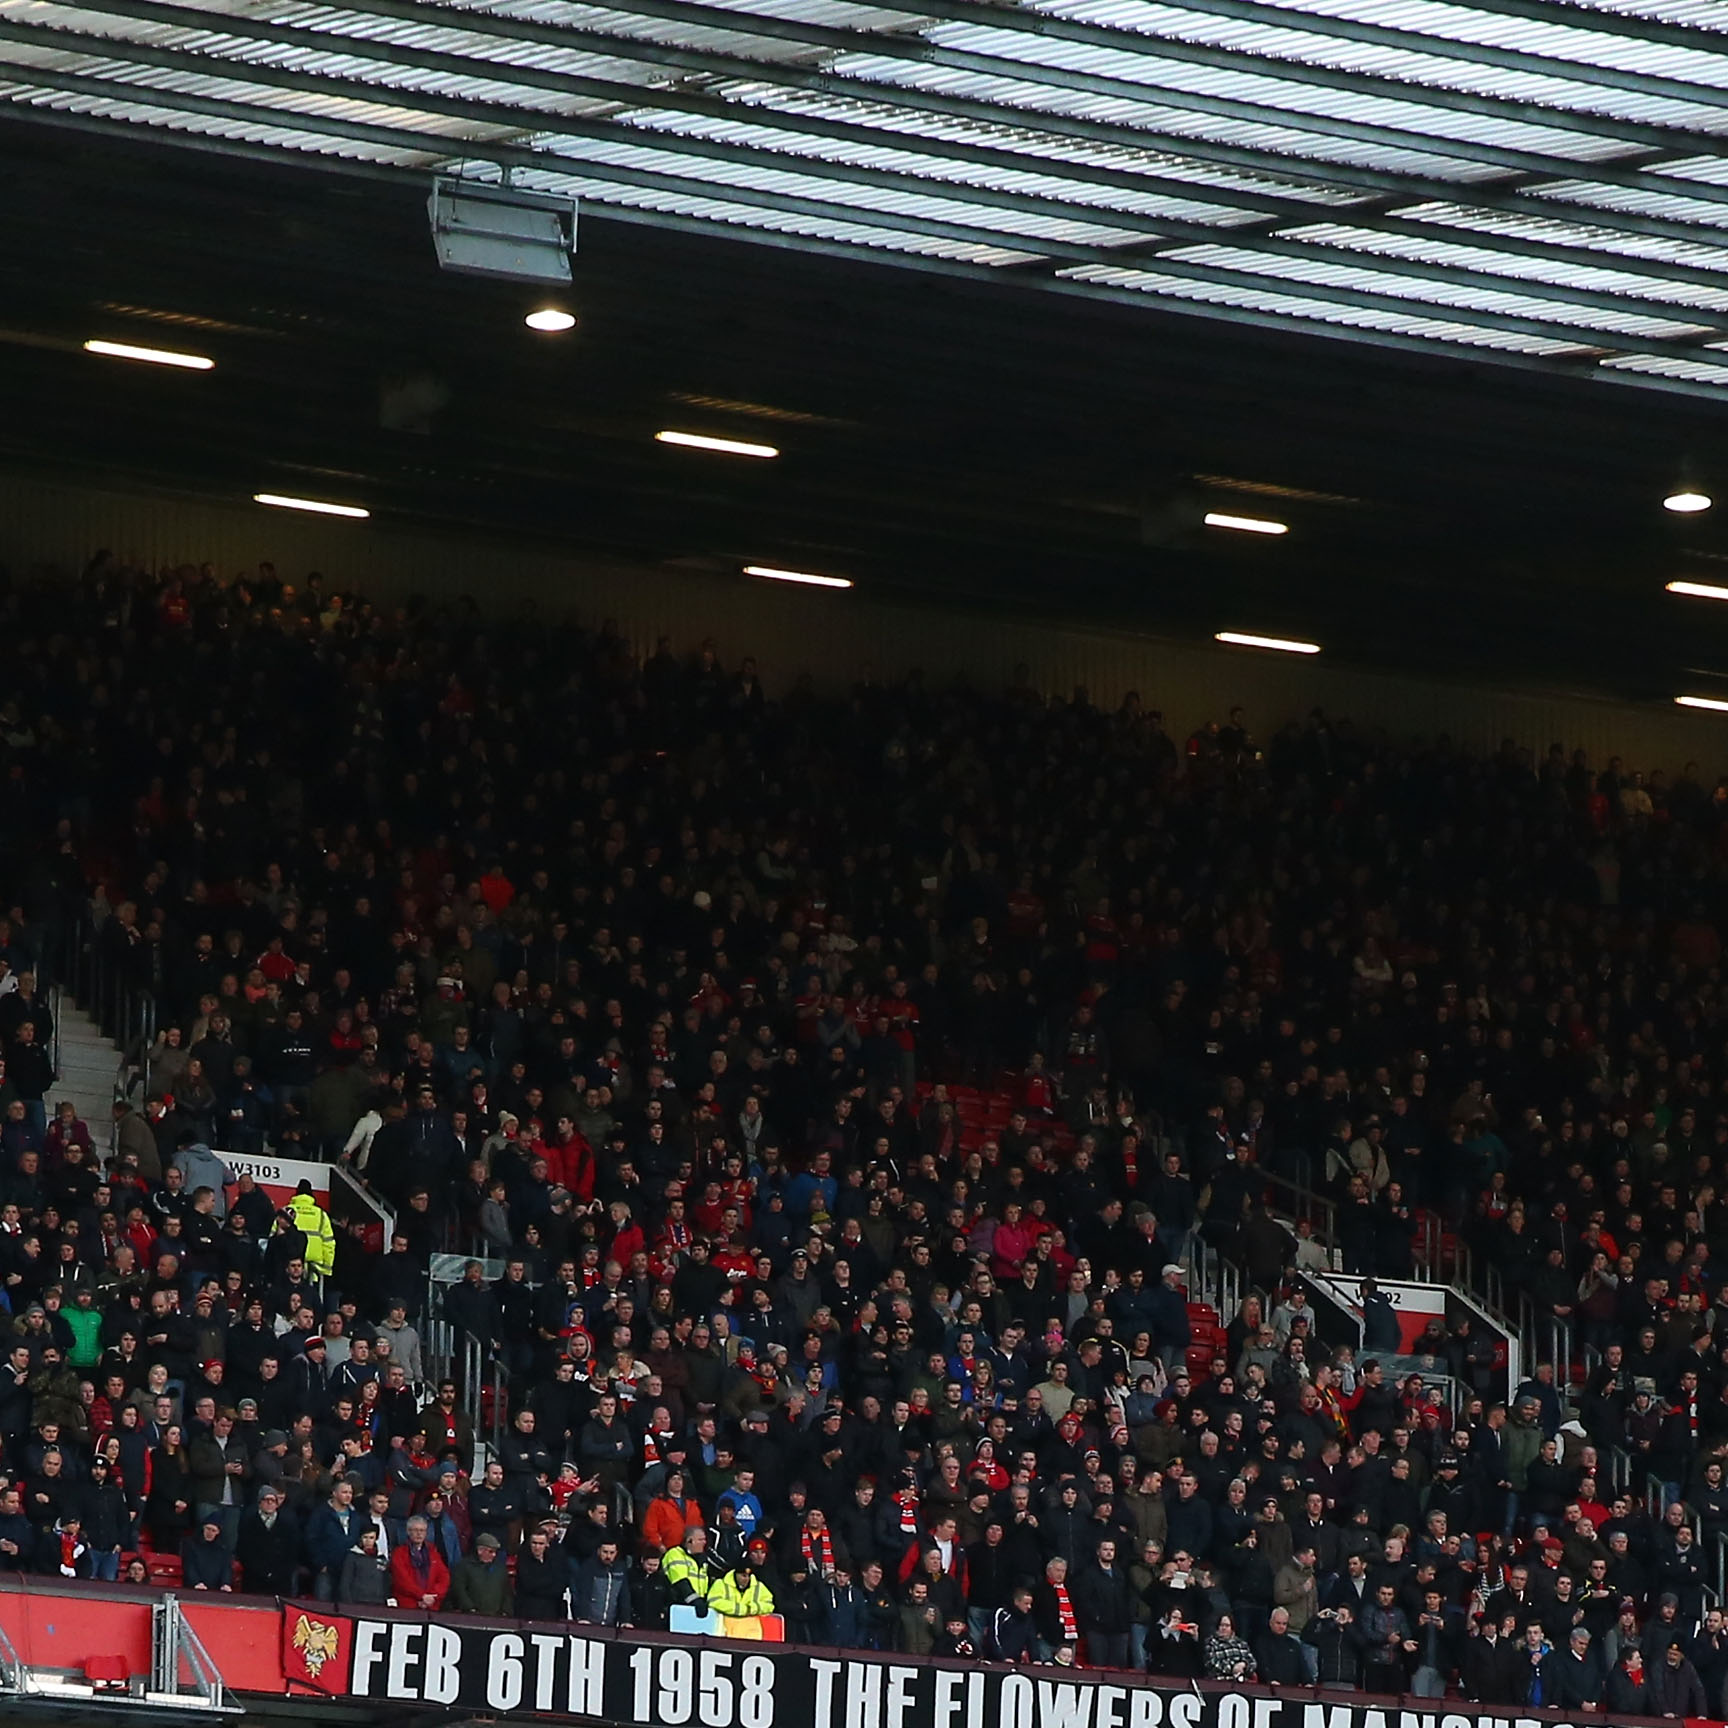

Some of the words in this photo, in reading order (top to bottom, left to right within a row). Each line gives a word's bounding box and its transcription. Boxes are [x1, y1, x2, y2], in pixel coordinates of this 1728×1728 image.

[228, 1161, 281, 1179] W3103
[352, 1620, 461, 1704] FEB
[487, 1632, 605, 1716] 6TH
